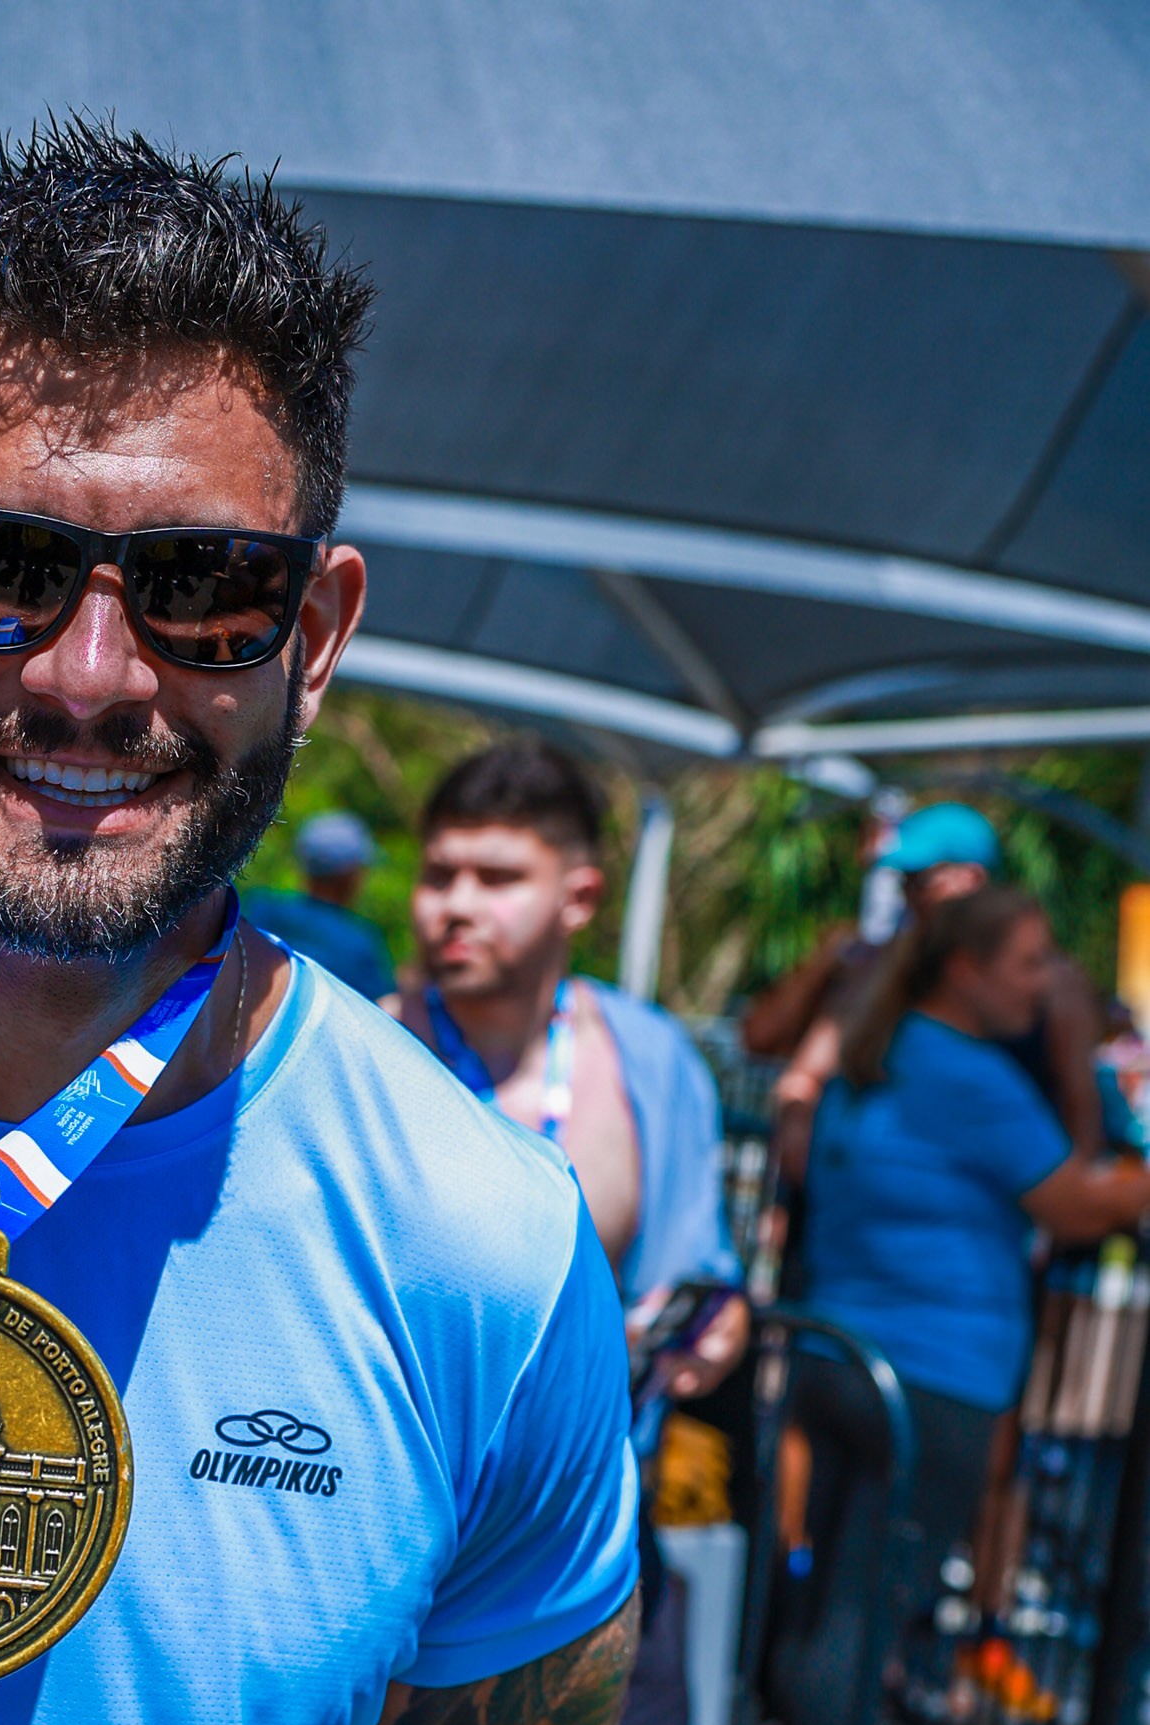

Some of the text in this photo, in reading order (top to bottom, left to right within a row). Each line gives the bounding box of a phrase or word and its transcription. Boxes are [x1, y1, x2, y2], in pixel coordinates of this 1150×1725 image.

[66, 1115, 95, 1145] MARATONA
[4, 1306, 34, 1337] DE
[32, 1329, 86, 1396] PORTO
[77, 1398, 110, 1483] ALEGRE
[189, 1448, 343, 1497] OLYMPIKUS
